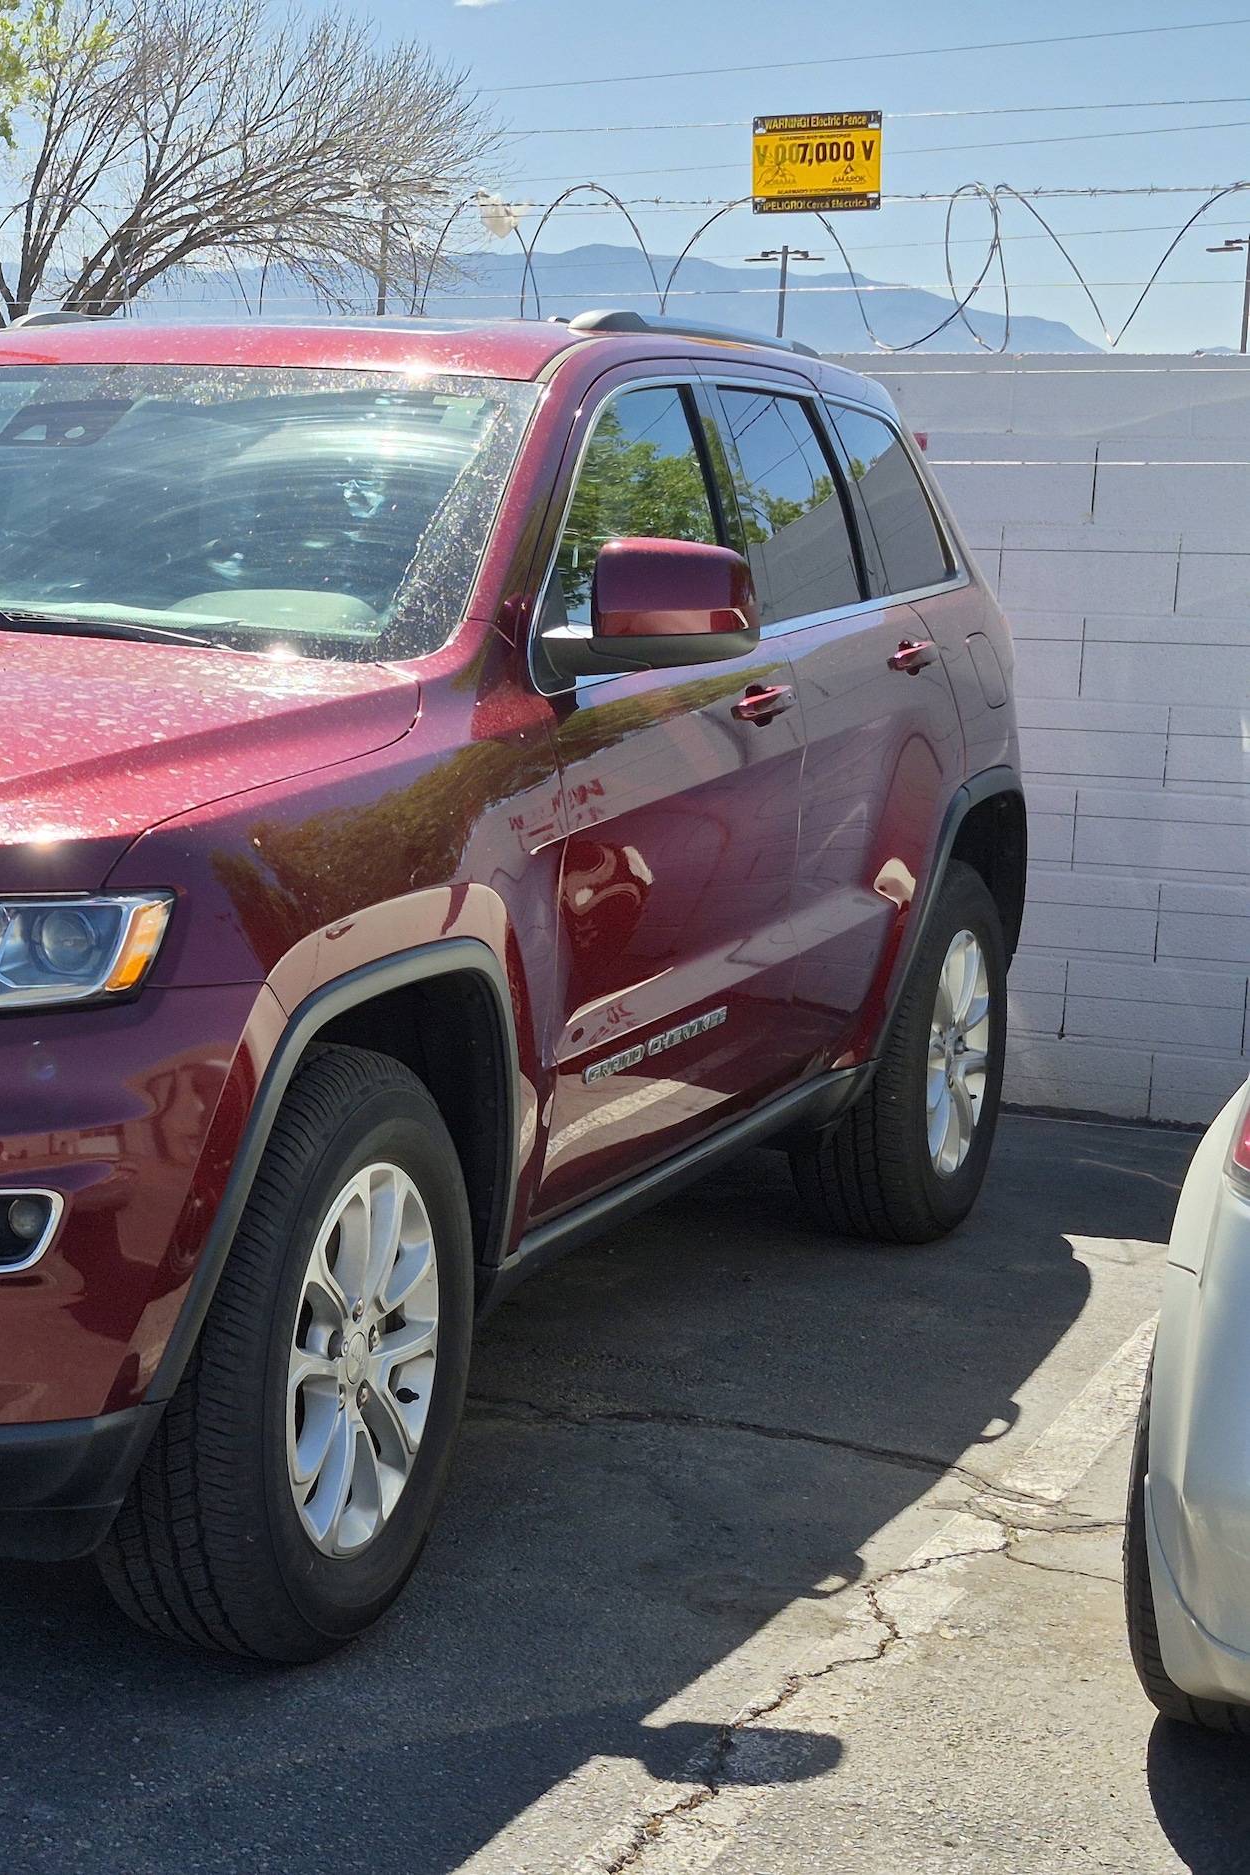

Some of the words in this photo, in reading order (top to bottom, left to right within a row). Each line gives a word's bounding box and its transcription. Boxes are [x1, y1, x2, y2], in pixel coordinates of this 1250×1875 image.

[811, 115, 841, 127] Electric
[842, 114, 867, 126] Fence
[797, 140, 855, 167] 7,000
[860, 140, 875, 161] V
[831, 174, 867, 184] AMAROK
[806, 200, 830, 210] Cerca
[582, 1043, 646, 1085] GRAND
[646, 1005, 728, 1057] CHEROKEE
